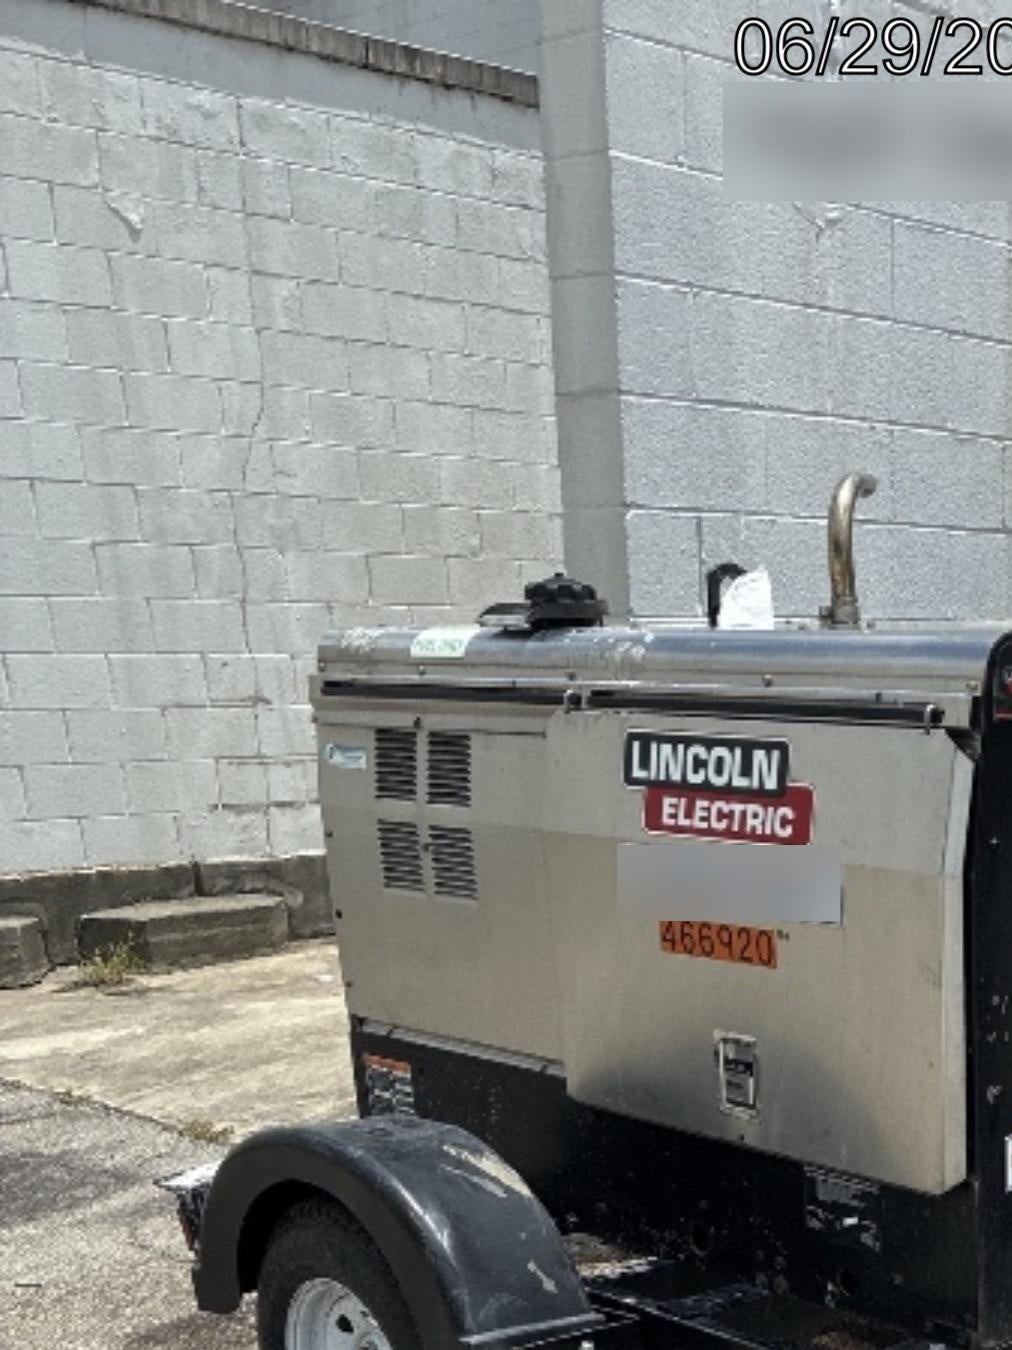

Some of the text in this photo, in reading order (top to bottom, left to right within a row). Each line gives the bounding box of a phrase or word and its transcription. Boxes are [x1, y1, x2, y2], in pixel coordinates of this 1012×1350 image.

[632, 740, 780, 790] LINCOLN
[661, 796, 796, 838] ELECTRIC
[661, 921, 773, 966] 466920
